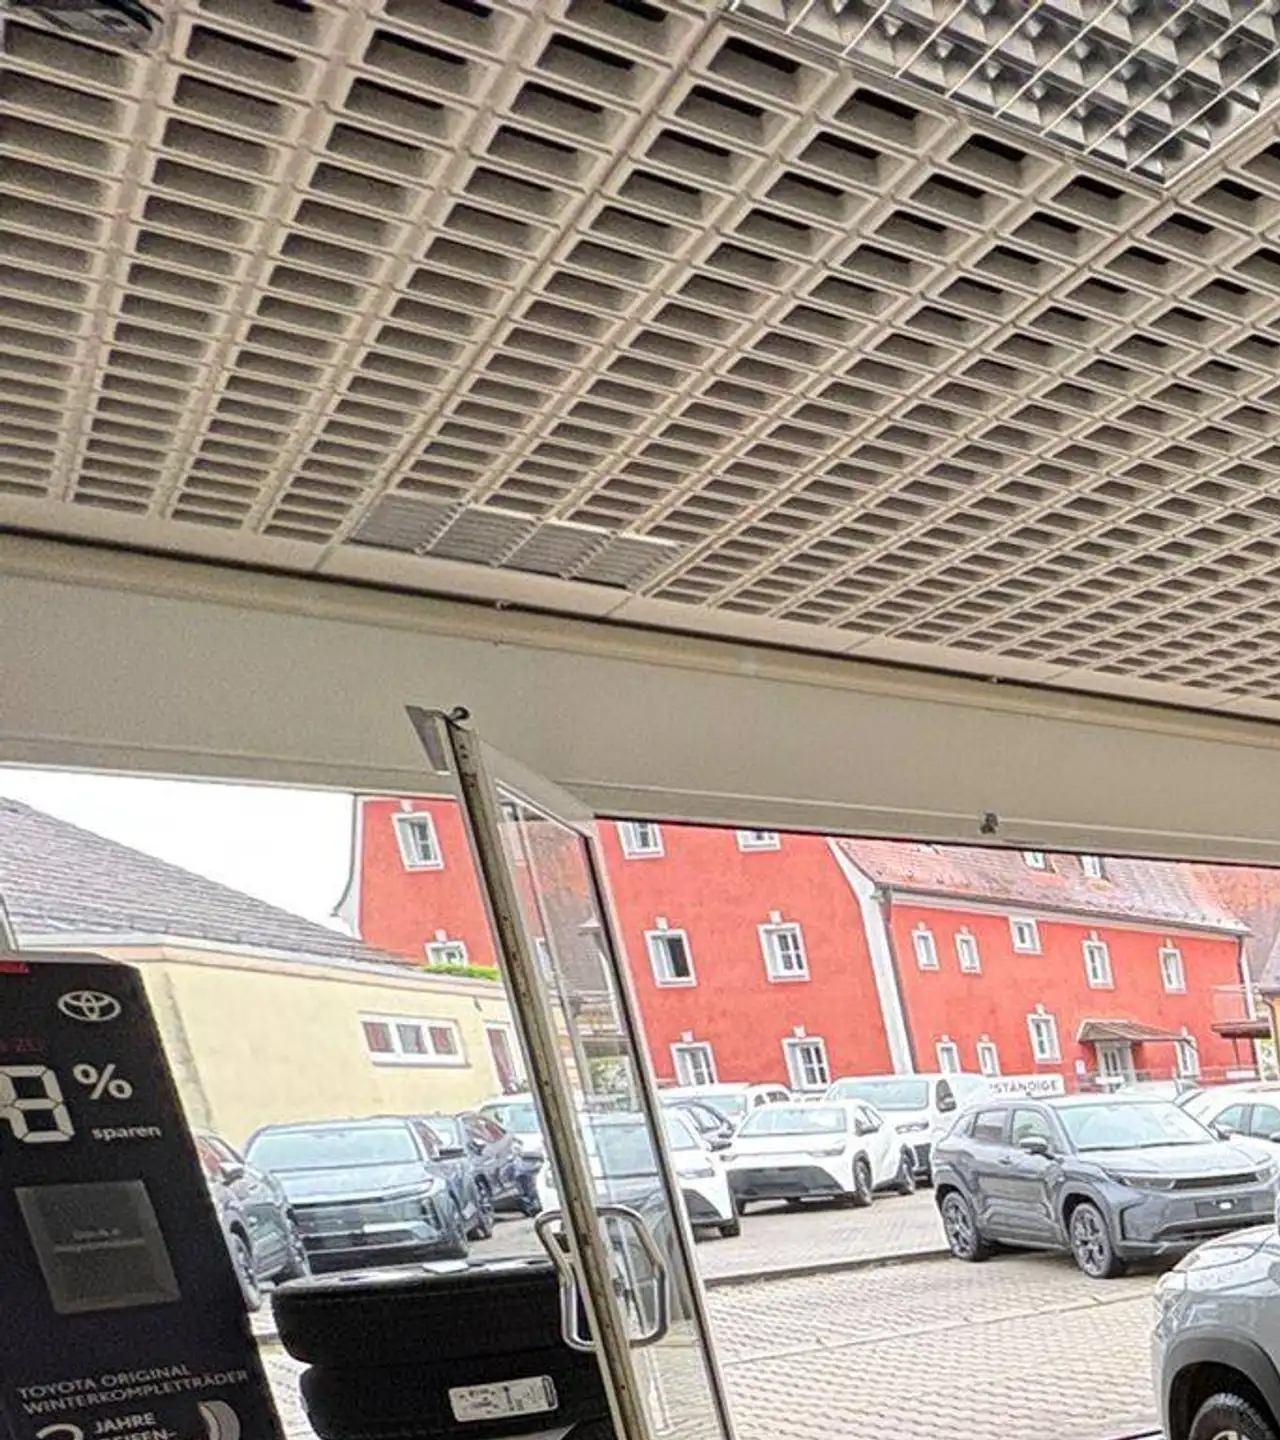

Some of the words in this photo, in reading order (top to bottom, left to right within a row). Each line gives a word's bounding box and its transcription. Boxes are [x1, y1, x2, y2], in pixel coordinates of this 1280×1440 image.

[72, 1063, 133, 1100] %
[91, 1125, 161, 1141] sparen
[18, 1377, 97, 1400] TOYOTA
[100, 1363, 191, 1389] ORIGINAL
[95, 1411, 157, 1434] JAHRE
